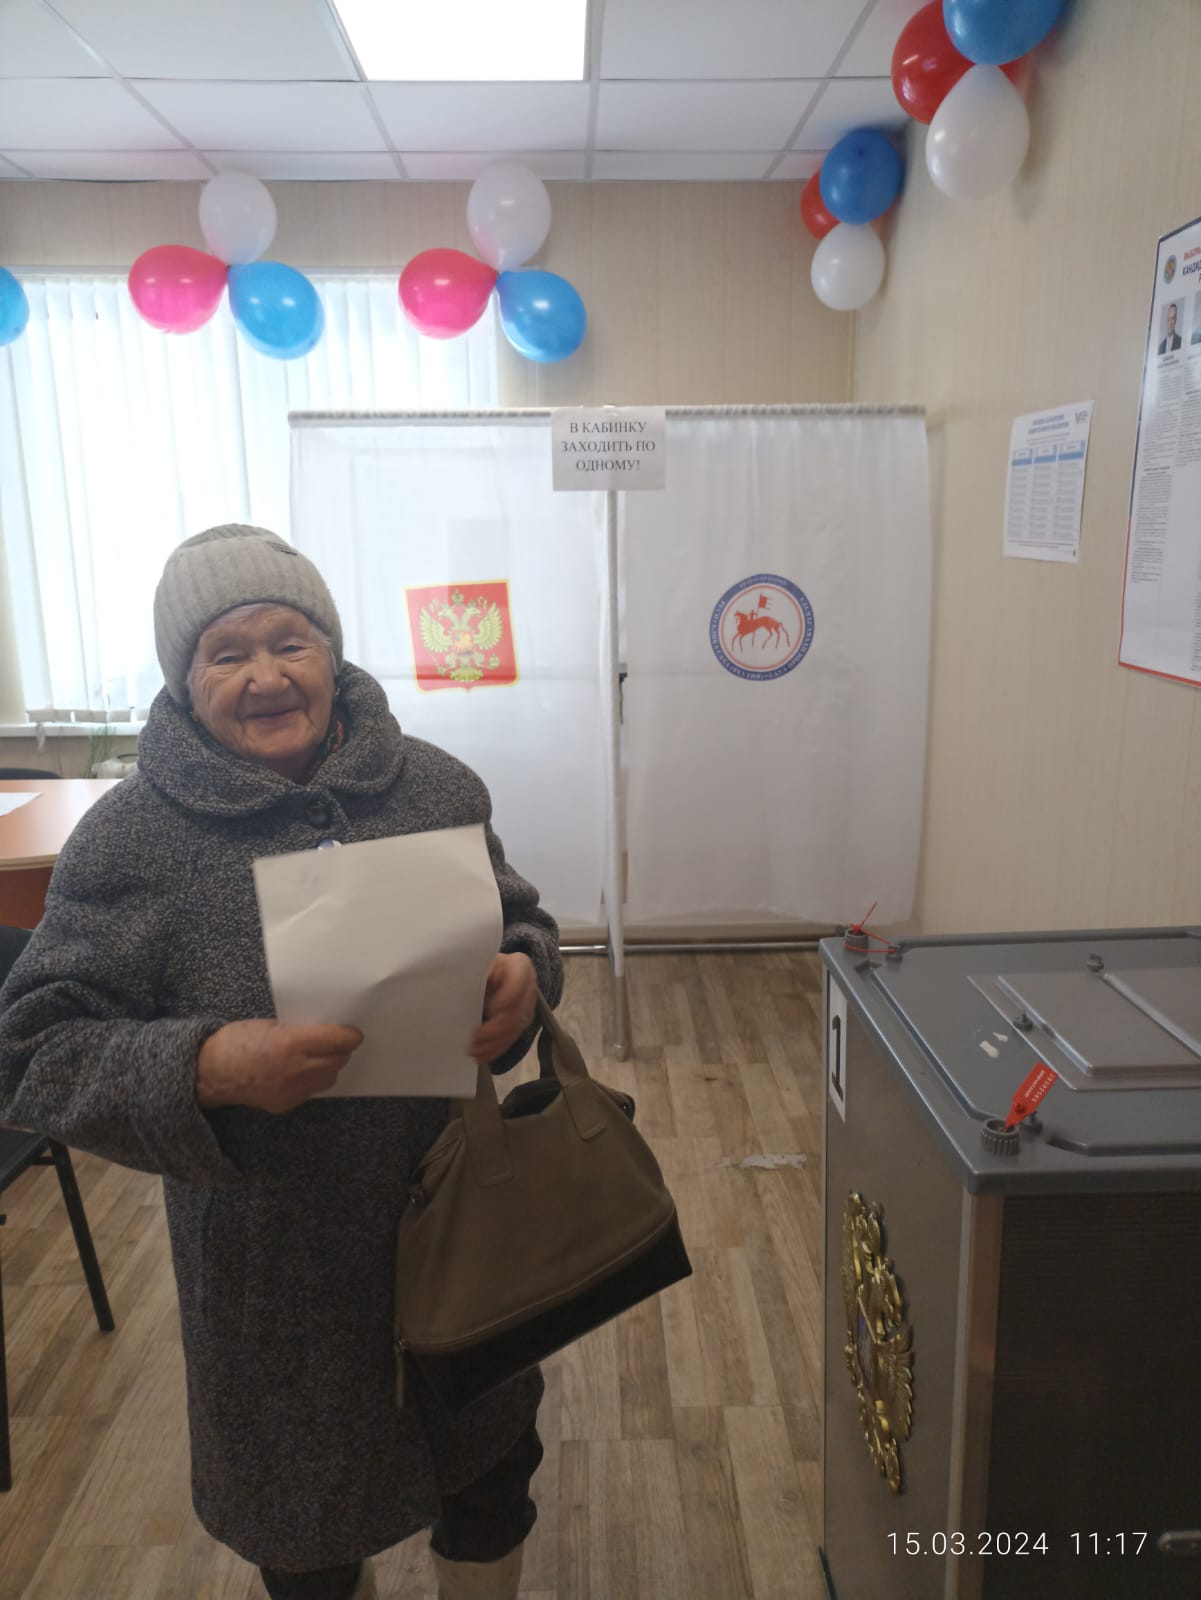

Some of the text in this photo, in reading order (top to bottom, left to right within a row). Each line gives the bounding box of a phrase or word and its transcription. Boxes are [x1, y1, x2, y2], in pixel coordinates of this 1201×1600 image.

[569, 421, 647, 433] В КАБИНКУ
[560, 440, 656, 453] ЗАХОДИТЬ ПО
[575, 459, 640, 472] ОДНОМУ!
[831, 1014, 844, 1103] 1
